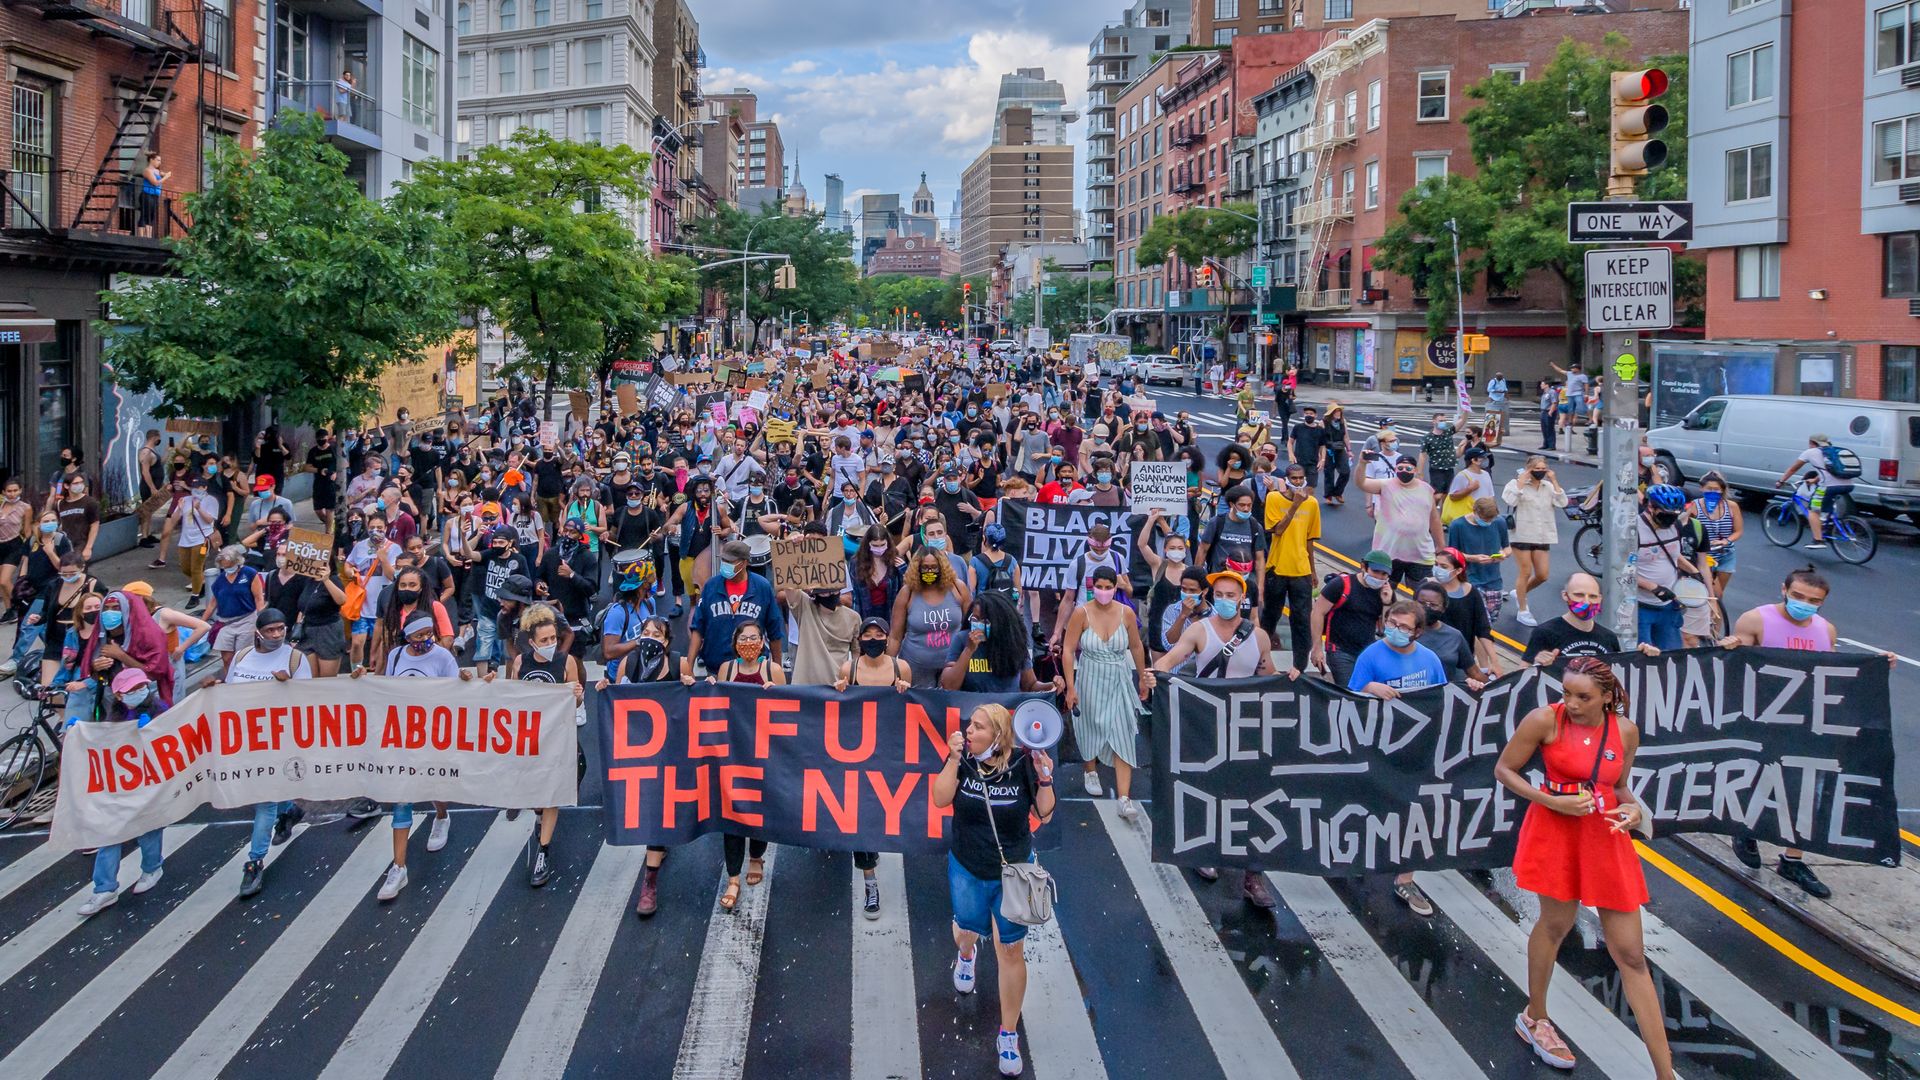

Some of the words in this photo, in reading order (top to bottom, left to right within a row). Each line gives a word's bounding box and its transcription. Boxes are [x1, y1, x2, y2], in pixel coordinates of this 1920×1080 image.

[1588, 215, 1622, 230] ONE
[1639, 215, 1675, 230] WAY
[1607, 258, 1649, 275] KEEP
[1591, 281, 1668, 298] INTERSECTION
[1602, 304, 1657, 321] CLEAR
[1436, 349, 1455, 357] LUC
[1438, 356, 1456, 364] SPO
[620, 369, 644, 377] ACTION
[1140, 464, 1173, 474] ANGRY
[1133, 484, 1161, 494] BLACK
[1161, 485, 1186, 495] LIVES
[1053, 495, 1068, 503] BLA
[1025, 506, 1132, 534] BLACK
[287, 541, 330, 561] PEOPLE
[776, 538, 827, 555] DEFUND
[1026, 534, 1128, 561] LIVS
[285, 560, 323, 577] POLICE
[775, 560, 846, 586] BASTARDS
[1021, 565, 1070, 590] MAT
[923, 608, 952, 624] LOVE
[930, 621, 949, 631] TO
[969, 658, 992, 673] ABOL
[613, 697, 1012, 764] DEFUN
[1168, 677, 1431, 775] DEFUND
[86, 713, 213, 794] DISARM
[219, 703, 368, 756] DEFUND
[381, 704, 541, 757] ABOLISH
[314, 762, 460, 779] DEFUNDNYPD.COM
[608, 763, 765, 829] THE
[1173, 780, 1516, 870] DESTIGMATIZE
